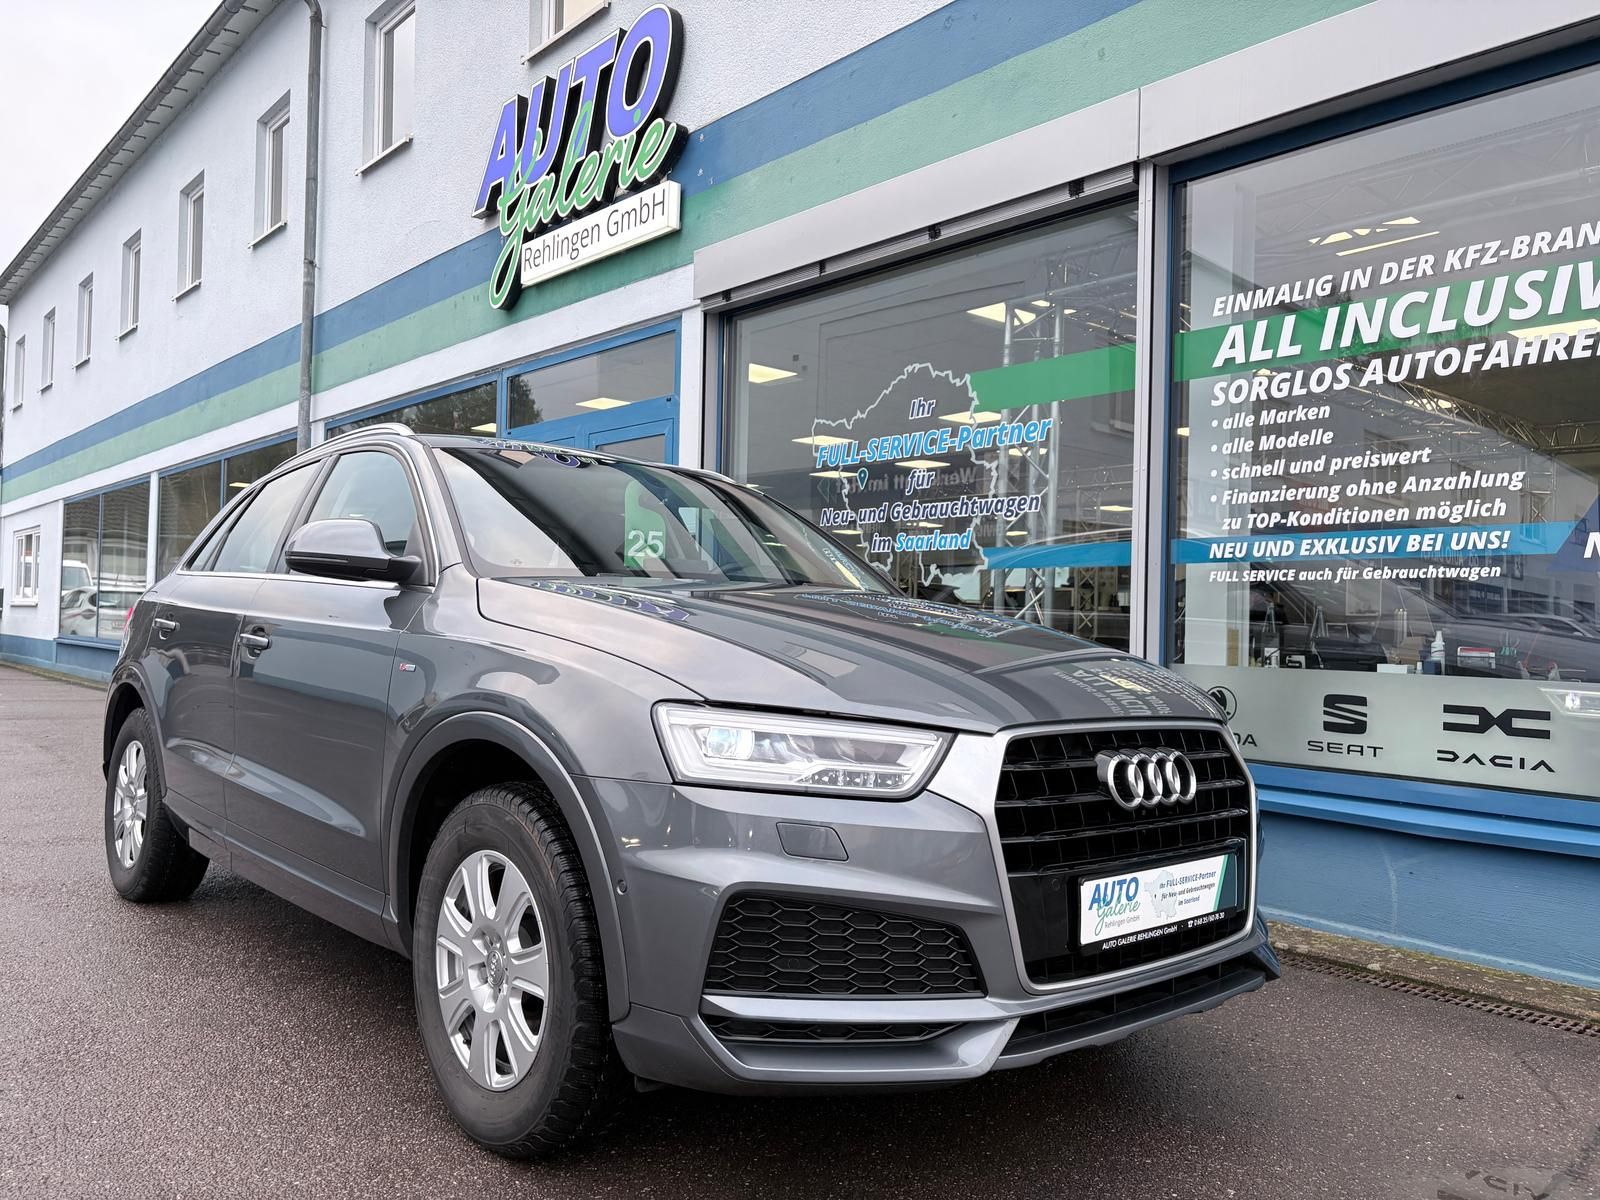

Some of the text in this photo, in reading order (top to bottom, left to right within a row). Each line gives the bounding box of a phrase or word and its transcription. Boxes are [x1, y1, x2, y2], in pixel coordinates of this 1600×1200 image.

[472, 3, 672, 218] AUTO
[523, 188, 666, 272] Rehlingen GmbH
[1212, 274, 1334, 318] EINMALIG
[1340, 266, 1373, 293] IN
[1379, 253, 1434, 285] DER
[1212, 315, 1302, 368] ALL
[1210, 327, 1600, 407] SORGLOS AUTOFAHRE
[909, 396, 936, 419] Ihr
[1222, 405, 1331, 430] alle Marken
[816, 418, 1052, 468] FULL-SERVICE-Partner
[1222, 428, 1334, 455] alle Modelle
[1222, 446, 1432, 480] schnell und preiswert
[906, 468, 936, 496] für
[1222, 468, 1526, 506] Finanzierung ohne Anzahlung
[820, 494, 1041, 527] Neu- und Gebrauchtwagen
[1222, 497, 1507, 531] zu TOP-Konditionen möglich
[627, 530, 664, 558] 25
[871, 533, 892, 553] im
[895, 527, 973, 552] Saarland
[1209, 530, 1511, 561] NEU UND EXKLUSIV BEI UNS!
[1209, 564, 1502, 585] FULL SERVICE auch für Gebrauchtwagen
[1307, 740, 1384, 758] SEAT
[1436, 749, 1556, 773] DACIA
[1088, 876, 1140, 911] AUTO
